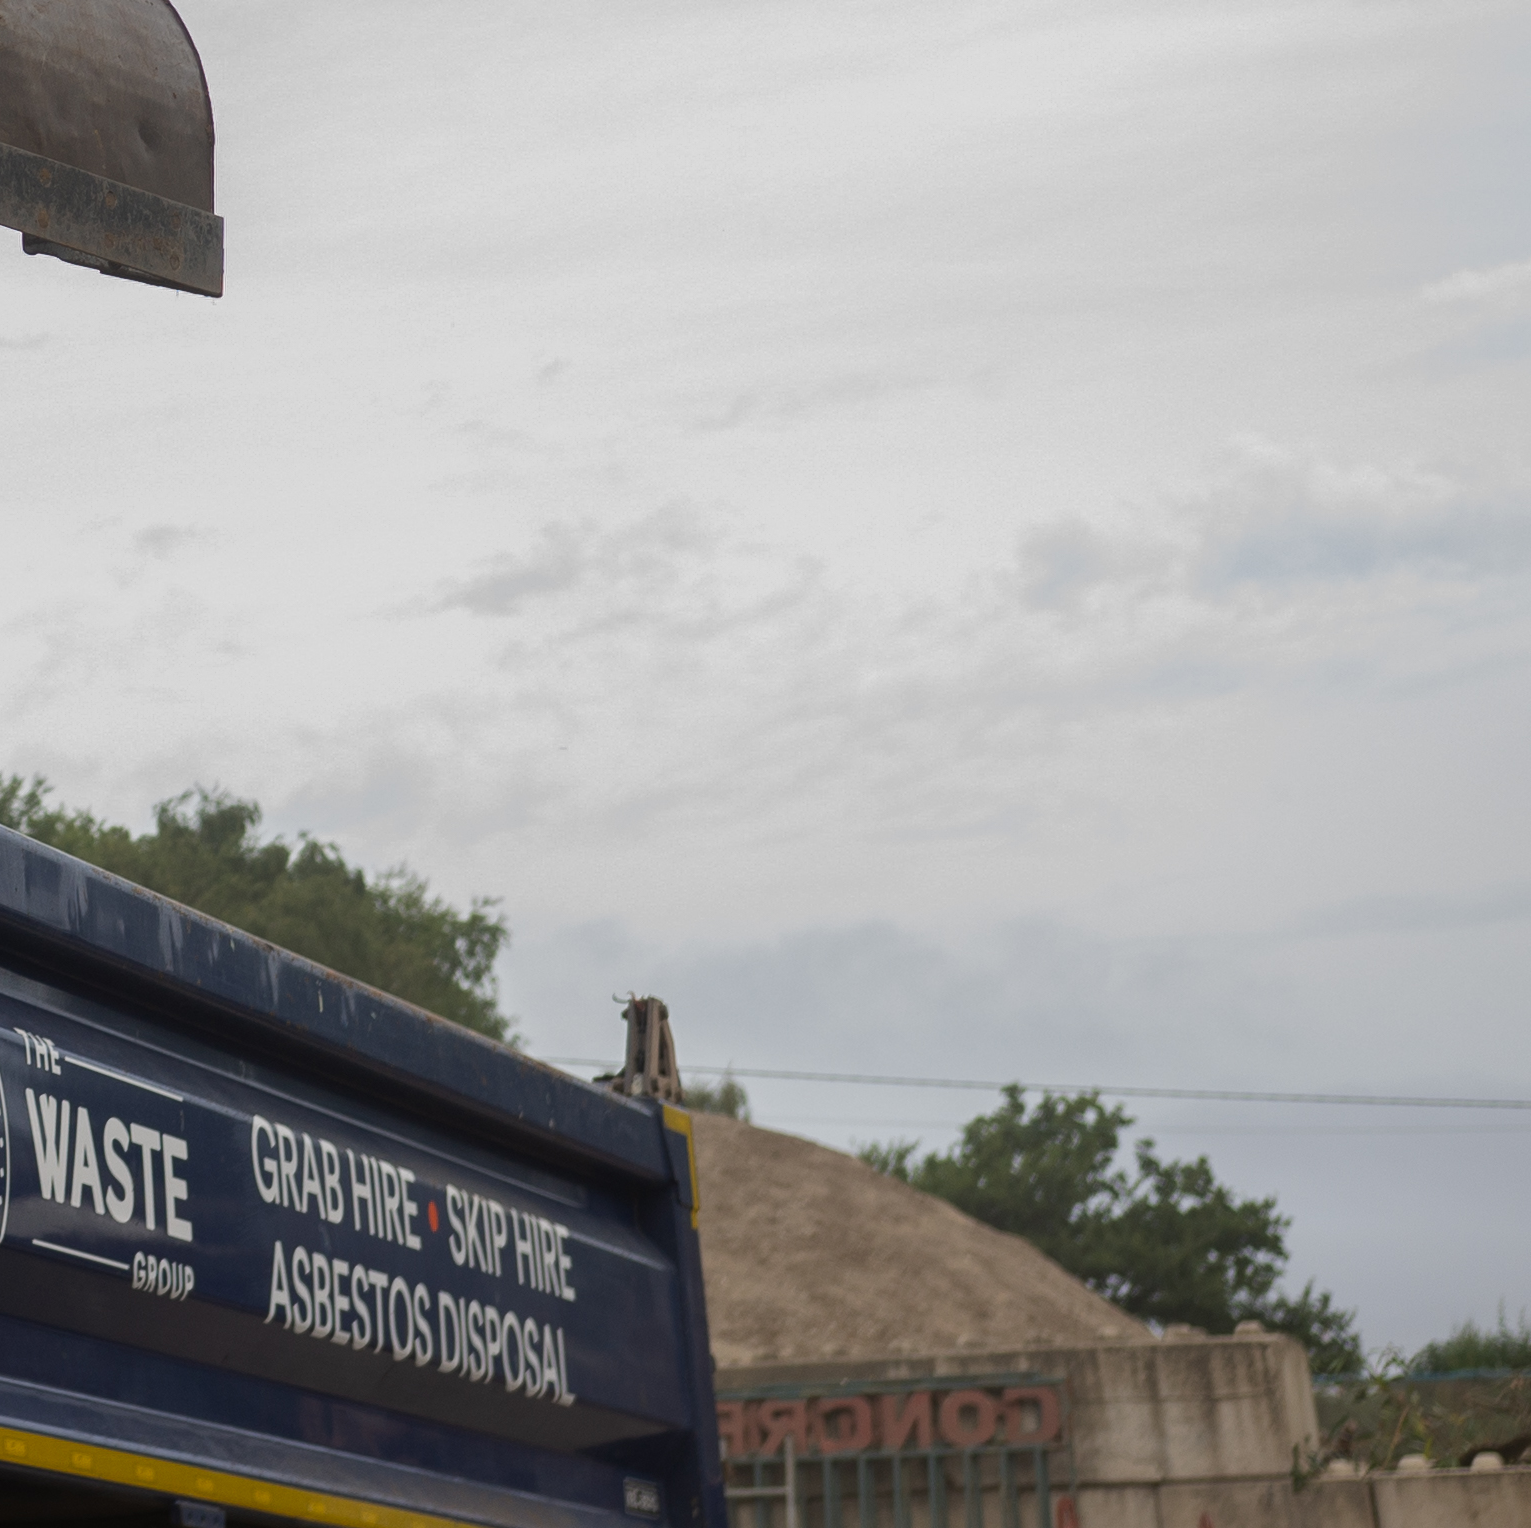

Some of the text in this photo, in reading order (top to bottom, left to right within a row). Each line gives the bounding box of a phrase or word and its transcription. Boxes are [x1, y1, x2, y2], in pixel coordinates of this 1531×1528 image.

[13, 1026, 63, 1076] THE
[25, 1087, 194, 1242] WASTE
[251, 1114, 576, 1302] GRAB HIRE SKIP HIRE
[131, 1251, 195, 1301] GROUP
[264, 1240, 576, 1406] ASBESTOS DISPOSAL
